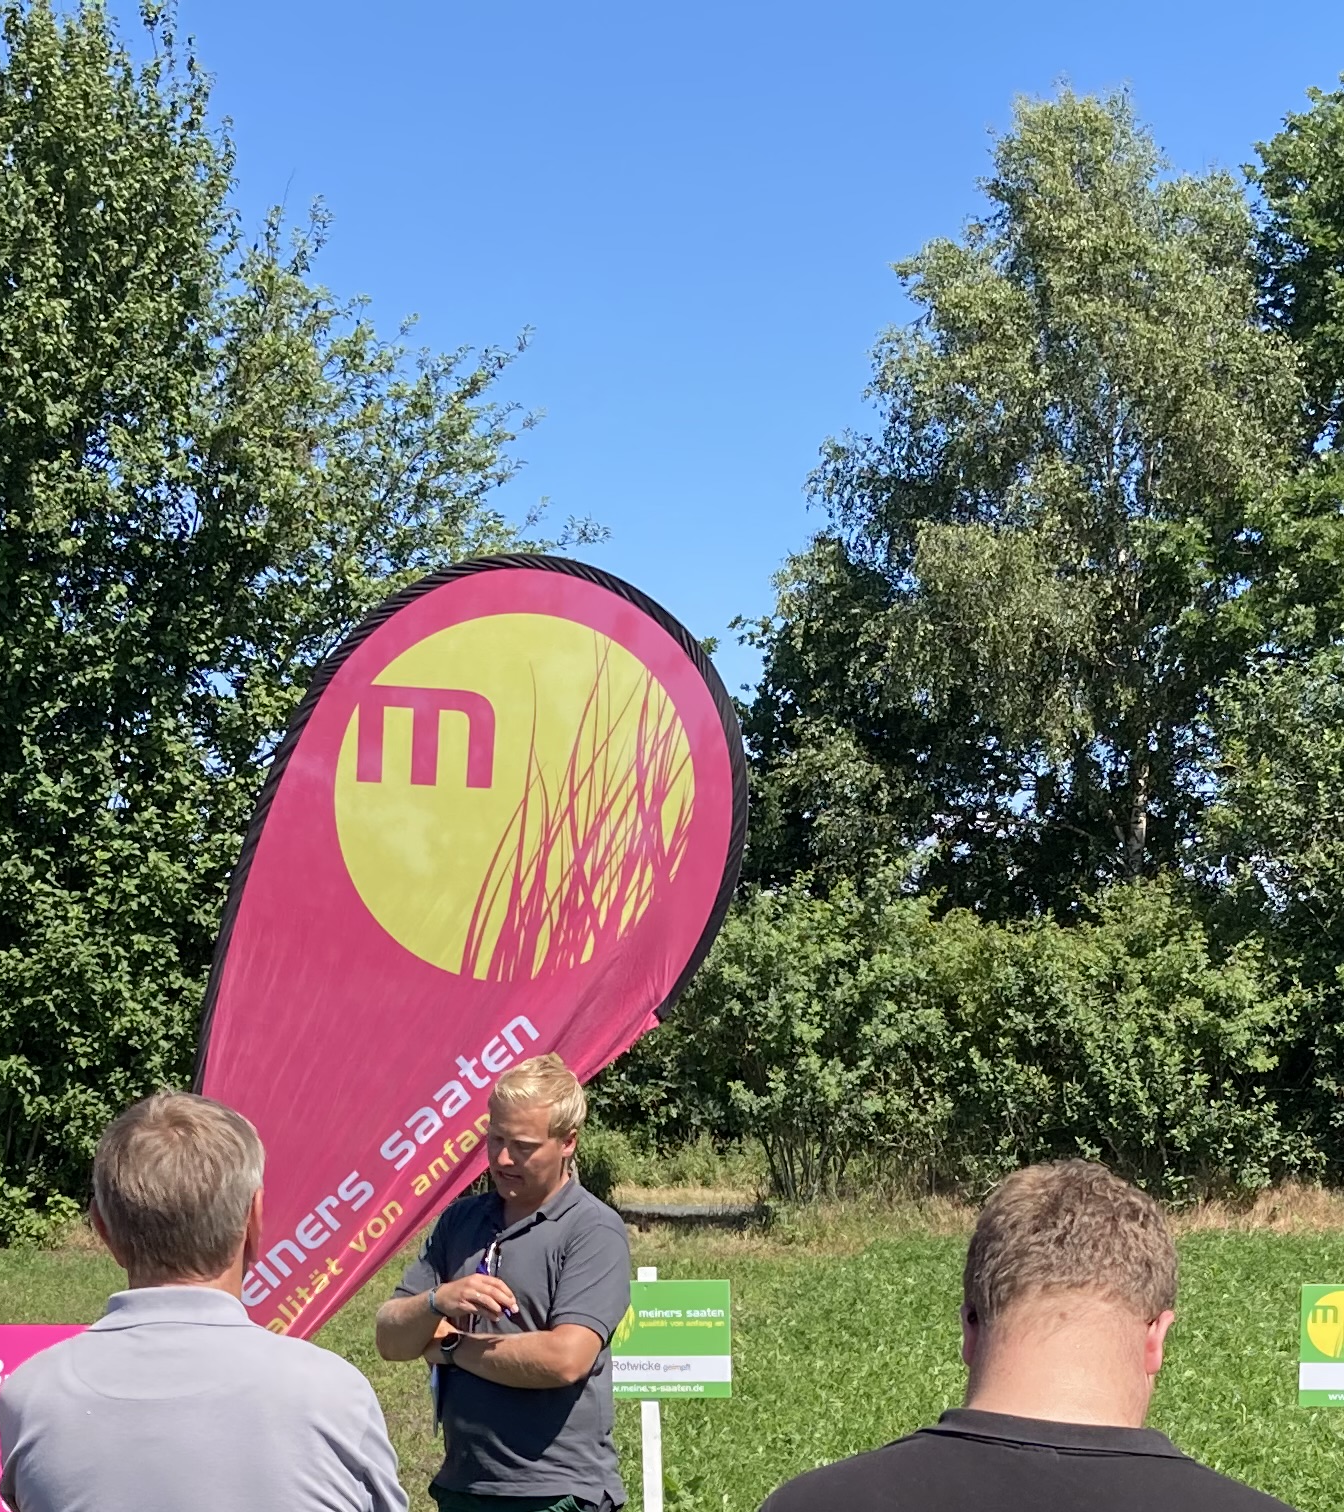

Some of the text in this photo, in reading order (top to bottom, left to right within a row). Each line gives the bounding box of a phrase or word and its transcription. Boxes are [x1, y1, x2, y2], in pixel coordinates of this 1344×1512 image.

[241, 1015, 541, 1307] einers saaten
[265, 1113, 491, 1336] alität von anfan
[612, 1360, 661, 1371] Rotwicke
[638, 1308, 724, 1318] meiners saaten
